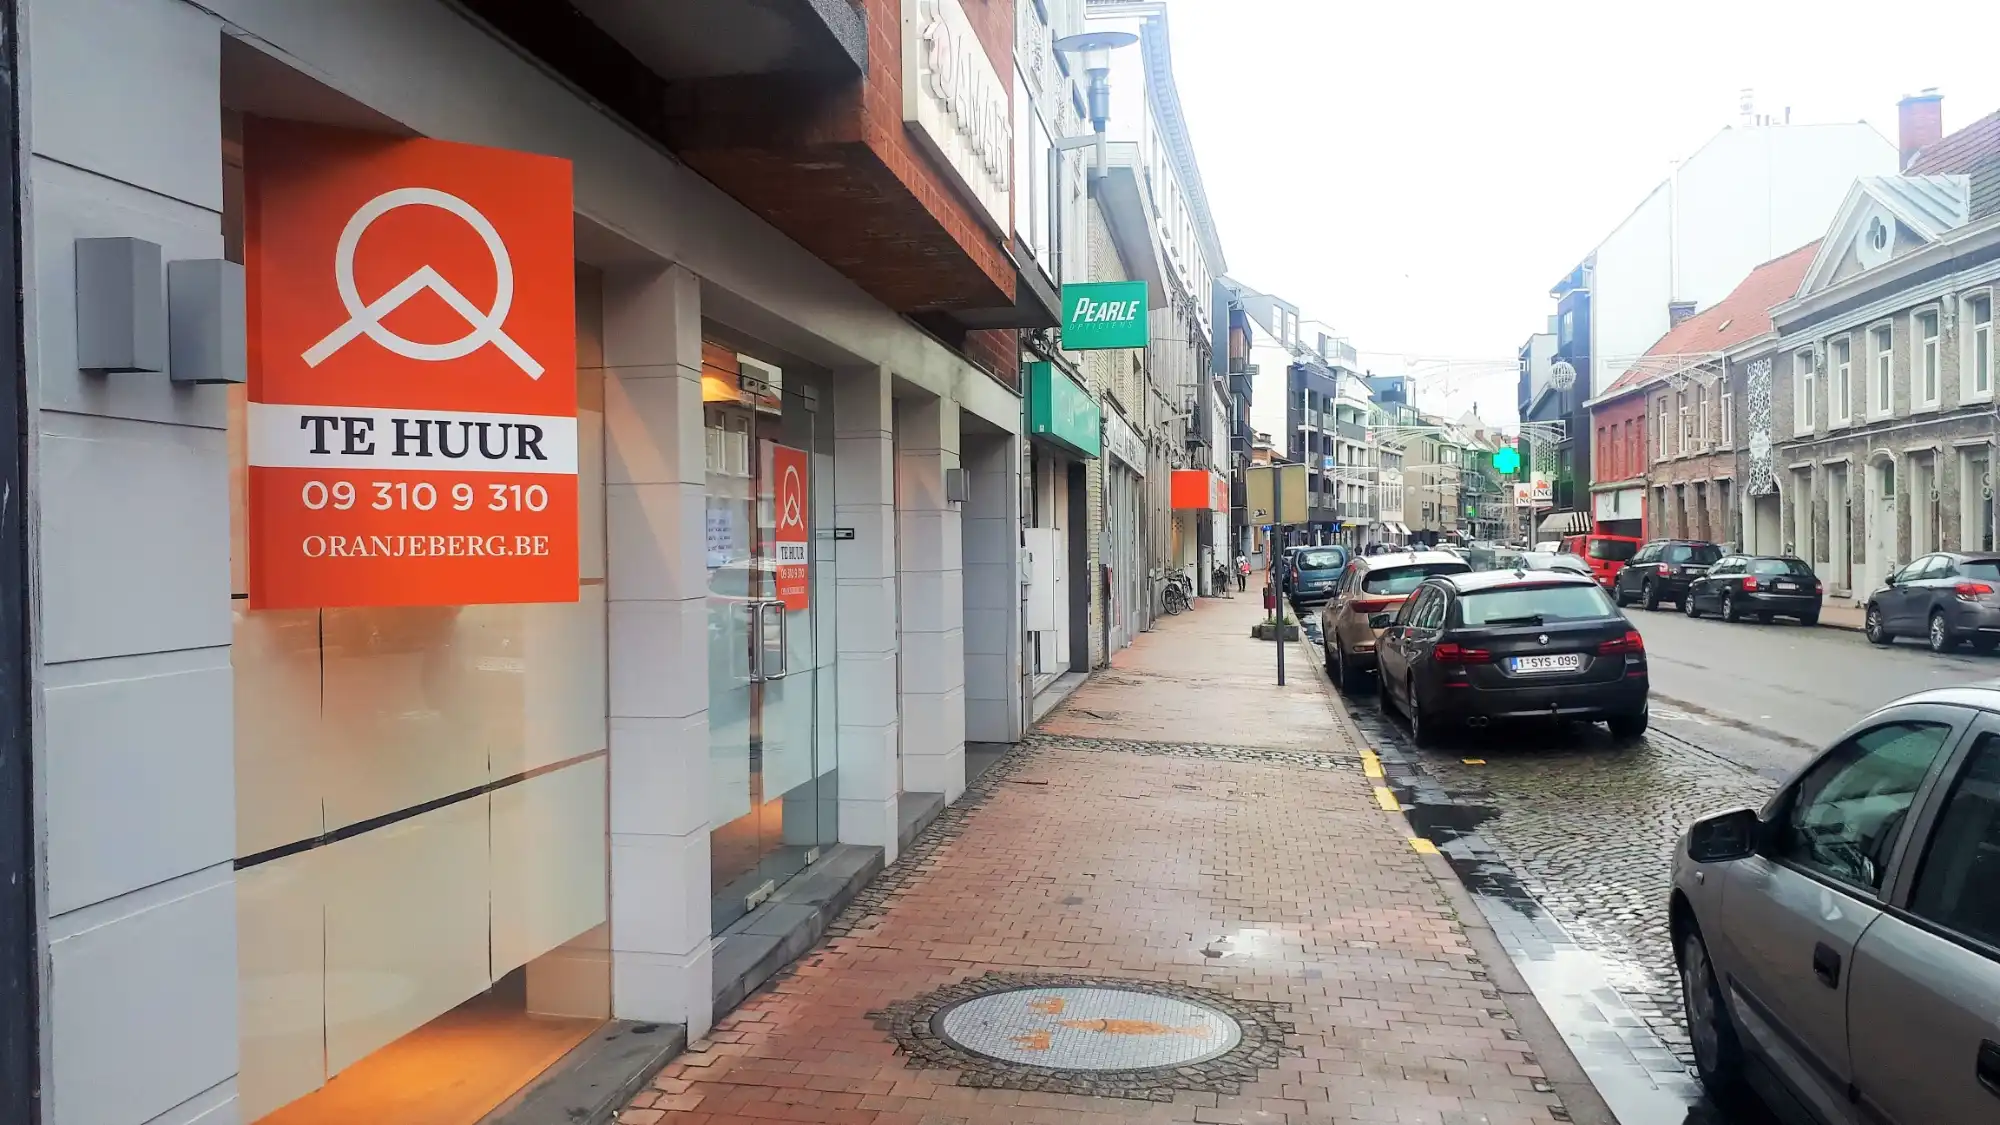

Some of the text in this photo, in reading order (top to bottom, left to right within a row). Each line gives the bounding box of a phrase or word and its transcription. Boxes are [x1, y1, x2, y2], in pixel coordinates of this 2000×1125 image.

[1072, 297, 1140, 323] PEARLE
[300, 415, 548, 460] TE HUUR
[302, 480, 548, 511] 09 310 9 310
[1533, 489, 1552, 497] ING
[302, 535, 549, 558] ORANJEBERG.BE
